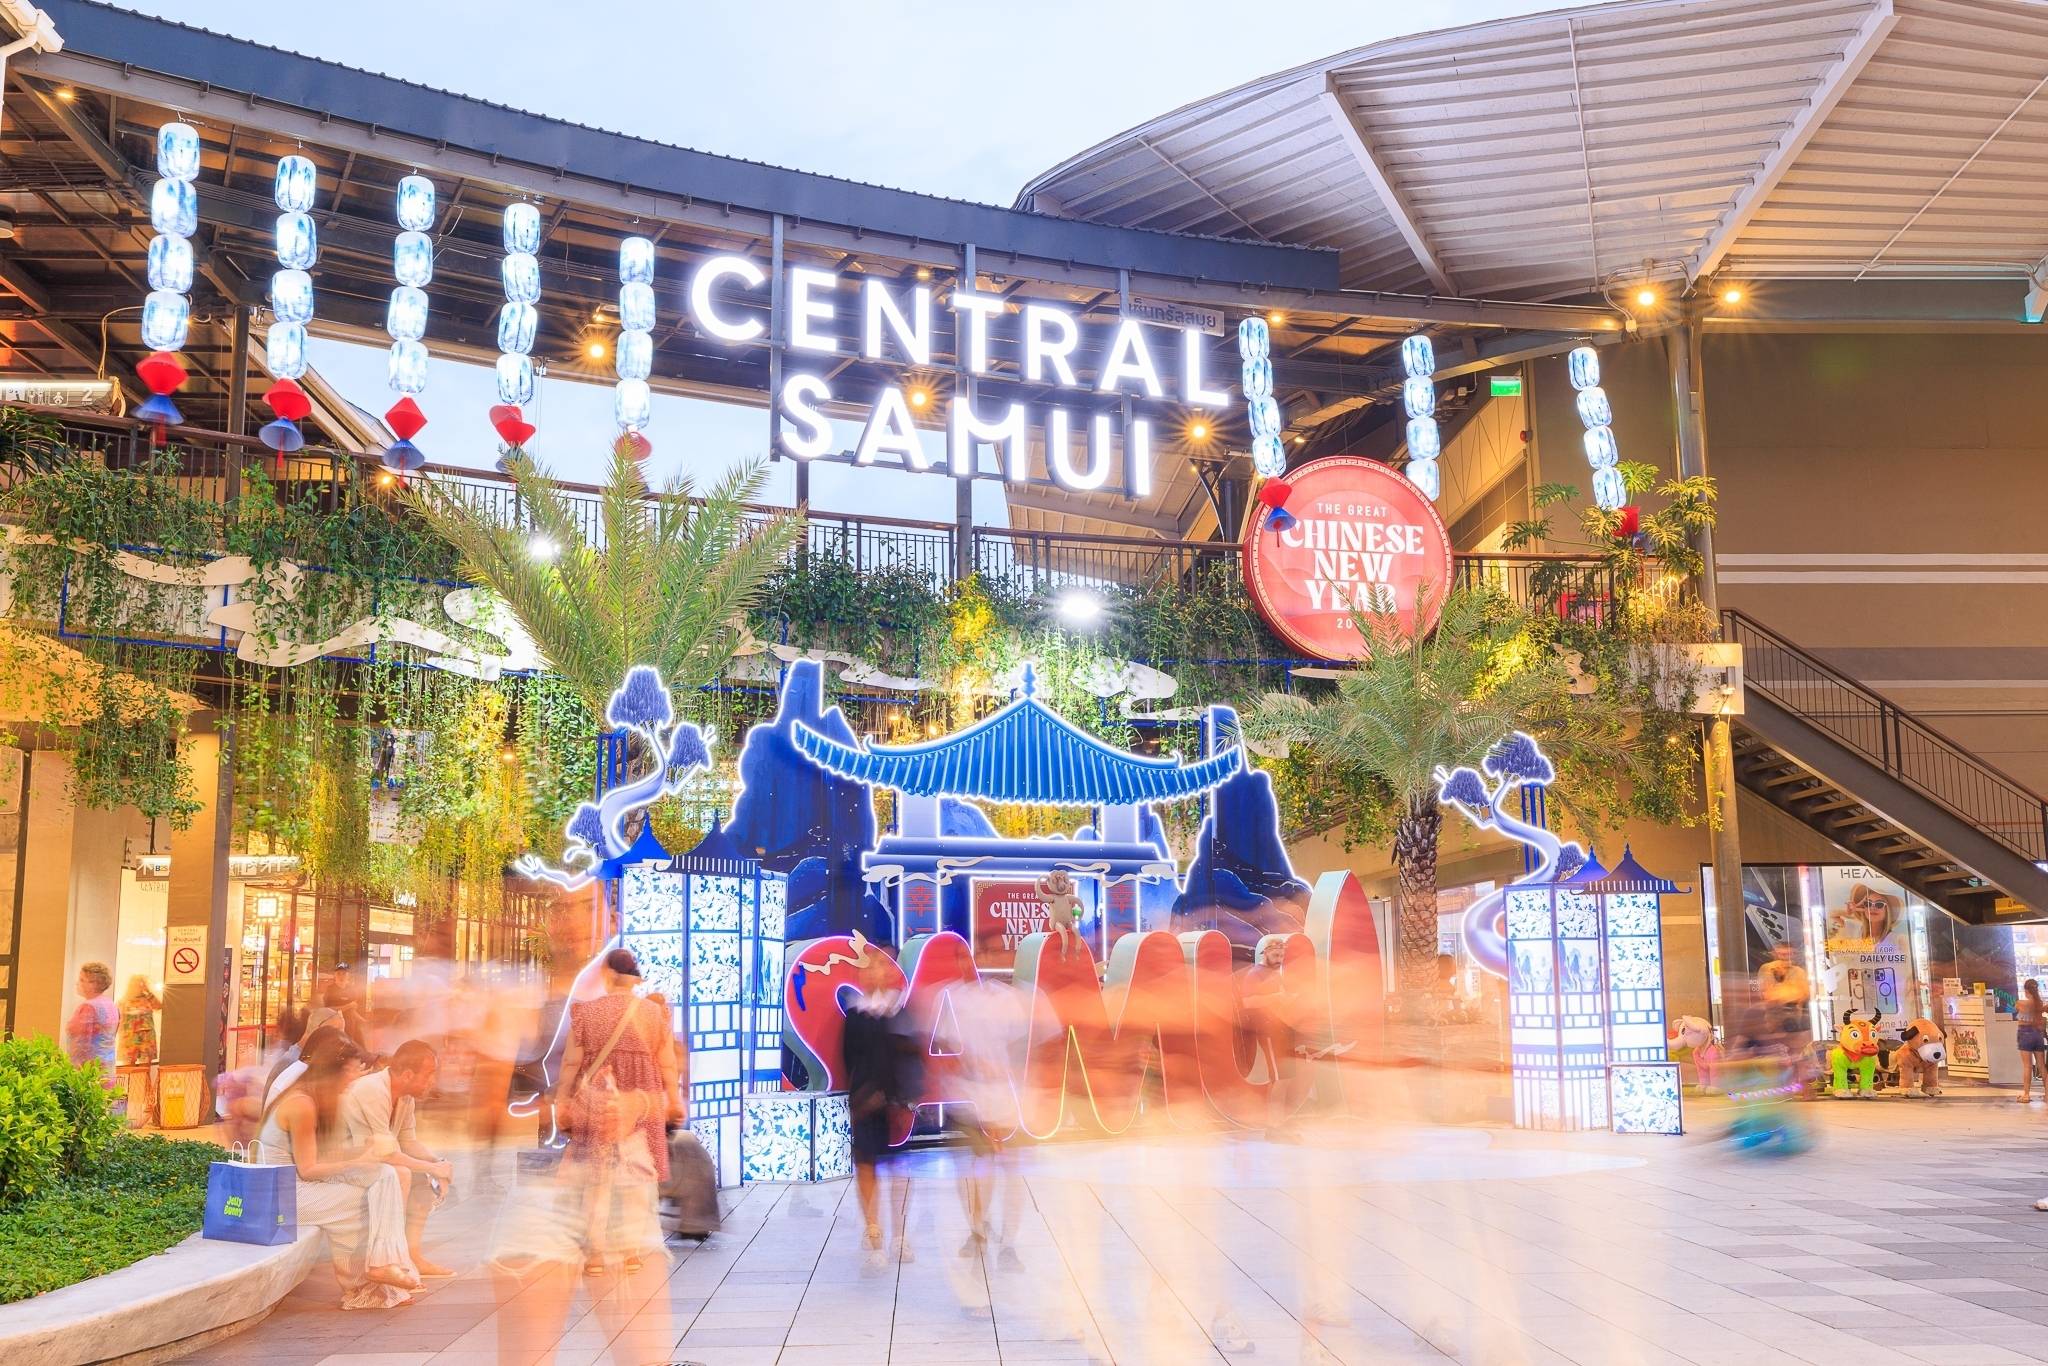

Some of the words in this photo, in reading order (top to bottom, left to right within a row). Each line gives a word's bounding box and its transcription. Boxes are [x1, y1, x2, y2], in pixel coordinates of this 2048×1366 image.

[691, 257, 1229, 407] CENTRAL
[81, 387, 93, 402] 2
[780, 374, 1152, 497] SAMUI
[1318, 502, 1341, 515] THE
[1347, 504, 1388, 518] GREAT
[1280, 519, 1424, 555] CHINESE
[1313, 550, 1393, 583] NEW
[1304, 580, 1398, 614] YEAR
[1336, 618, 1371, 630] 20
[1008, 892, 1020, 900] THE
[1022, 892, 1041, 900] GREA
[990, 902, 1050, 919] CHINES
[1006, 918, 1046, 935] NEW
[1001, 934, 1023, 951] YE
[1860, 954, 1886, 963] DAILY
[1887, 954, 1905, 962] USE
